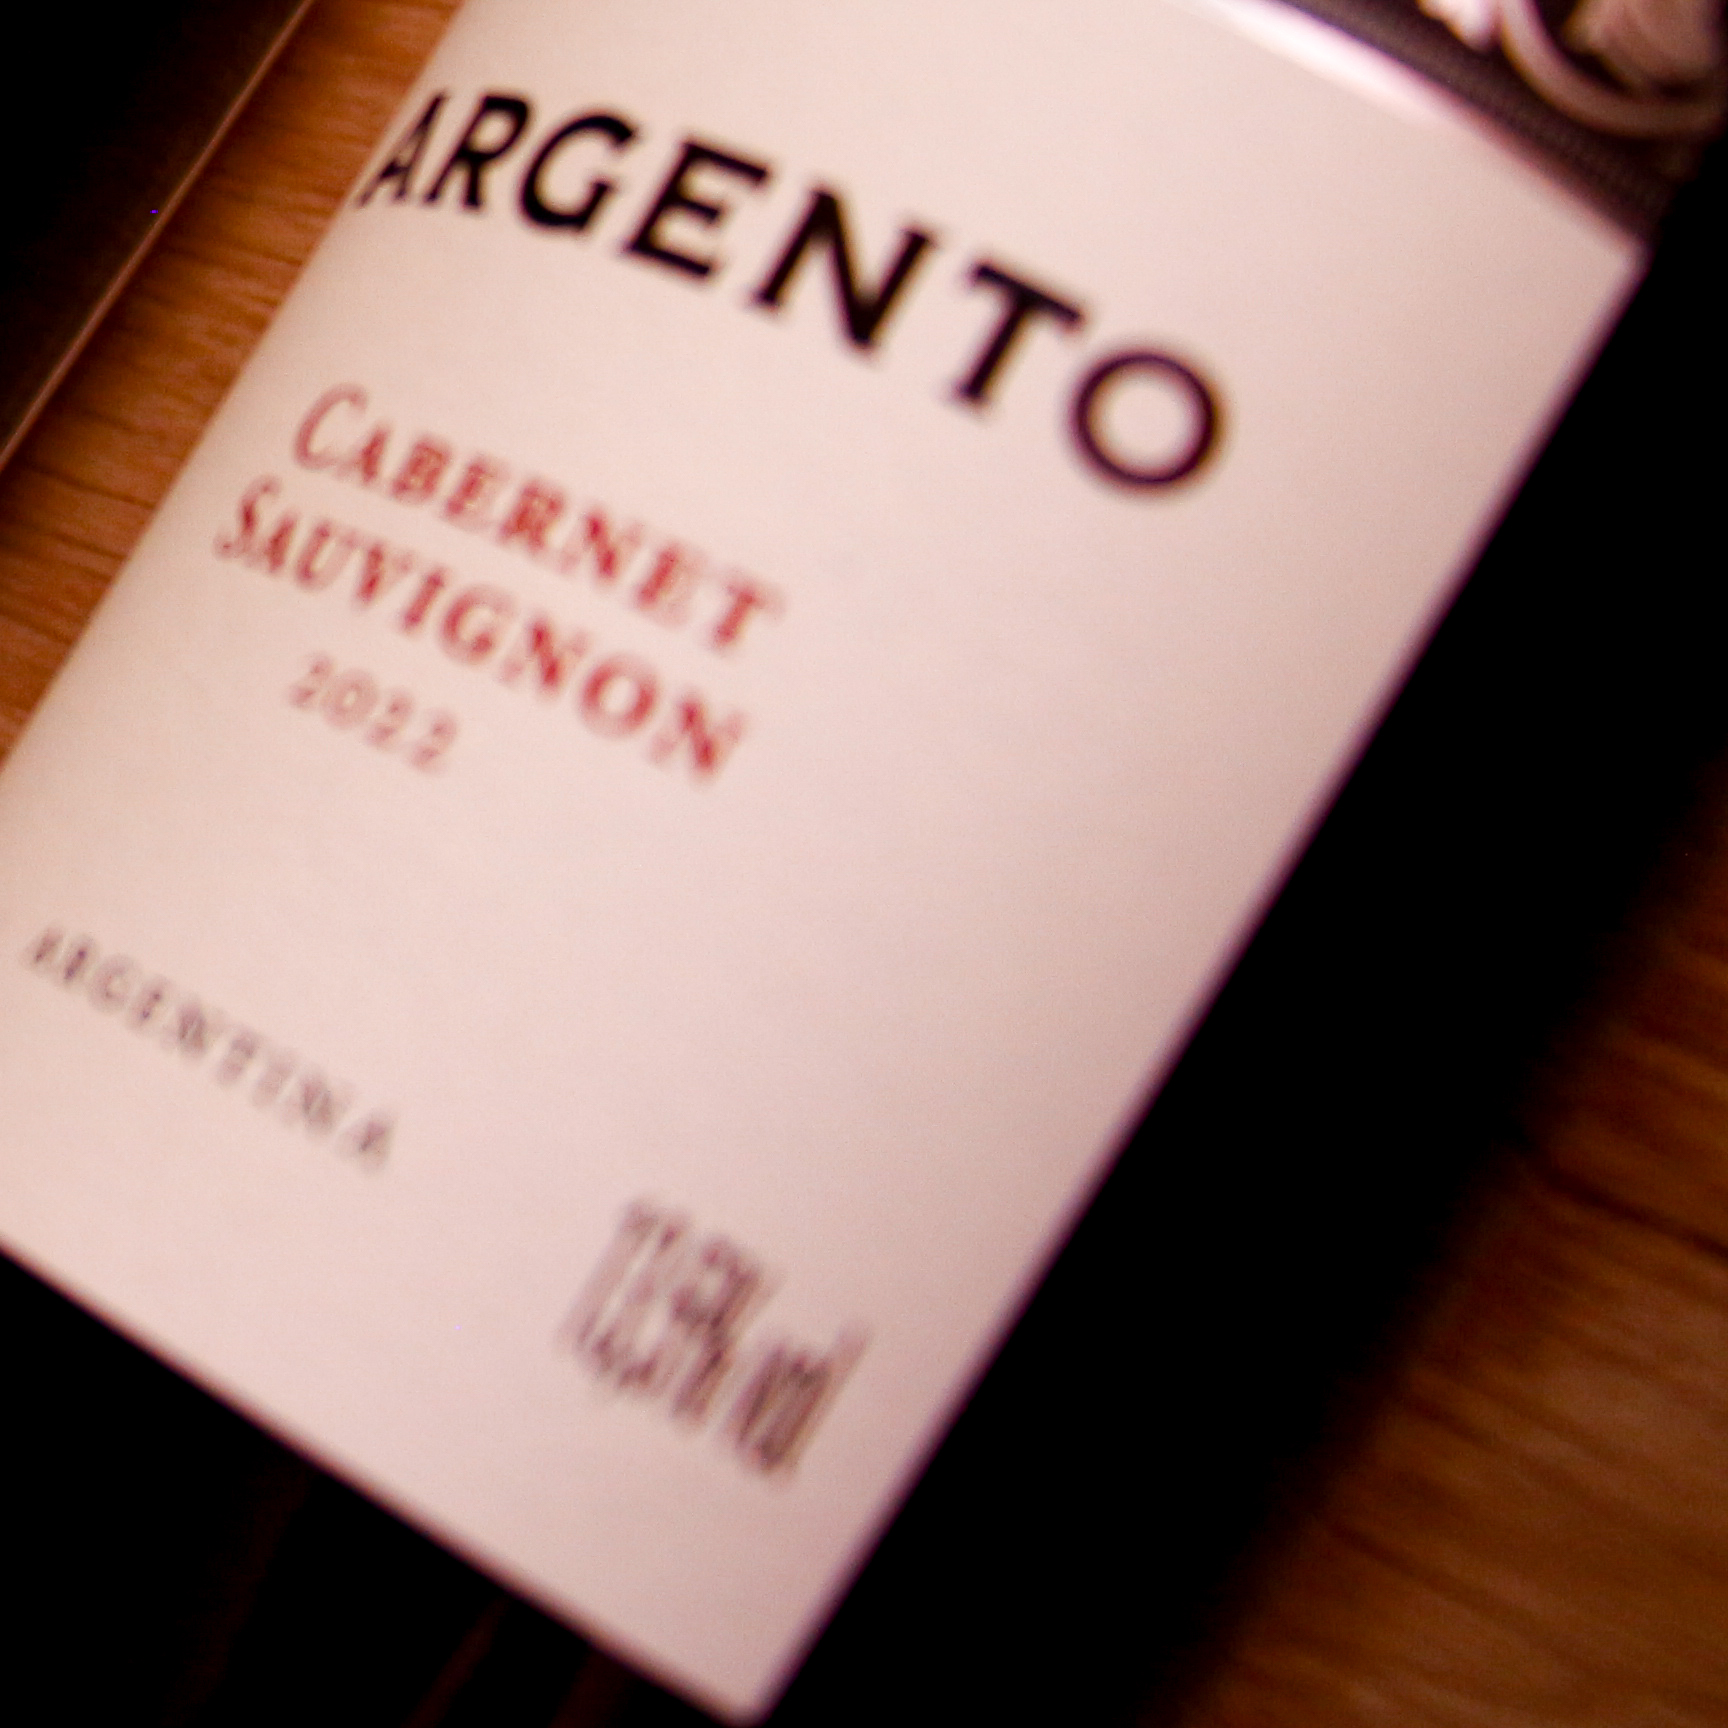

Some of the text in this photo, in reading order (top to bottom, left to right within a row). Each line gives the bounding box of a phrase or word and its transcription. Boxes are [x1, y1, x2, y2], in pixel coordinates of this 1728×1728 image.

[354, 87, 1232, 496] ARGENTO
[213, 474, 747, 782] SAUVIGNON
[292, 381, 786, 656] CABERNET
